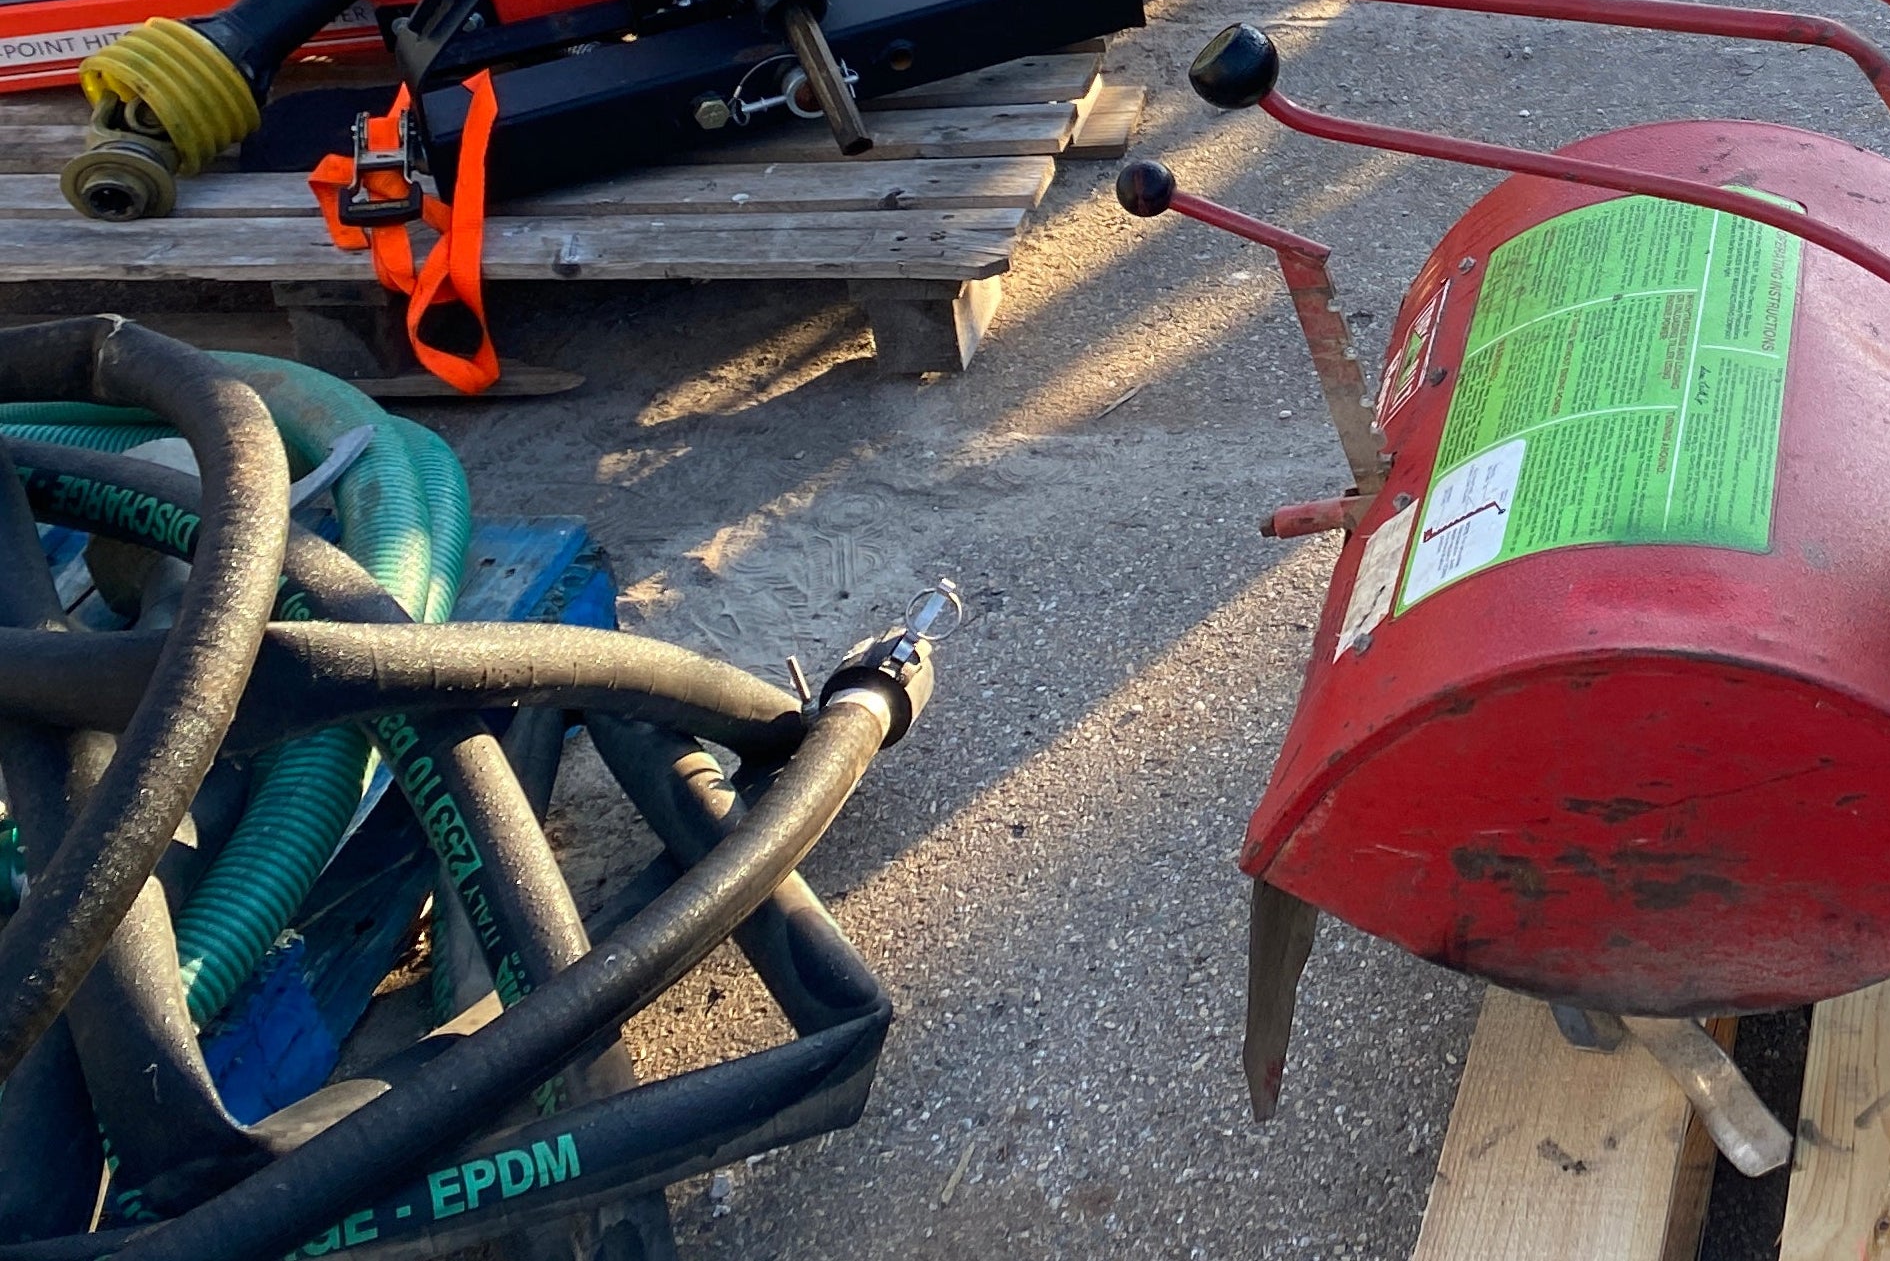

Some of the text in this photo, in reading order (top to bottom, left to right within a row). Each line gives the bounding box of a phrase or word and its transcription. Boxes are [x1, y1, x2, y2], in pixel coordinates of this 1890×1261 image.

[82, 30, 133, 51] HIT
[1762, 230, 1787, 353] OPERATING INSTRUCTIONS
[51, 475, 201, 555] DISCHARGE
[374, 712, 501, 950] ITALY 253 10 ba
[428, 1133, 581, 1220] EPDM
